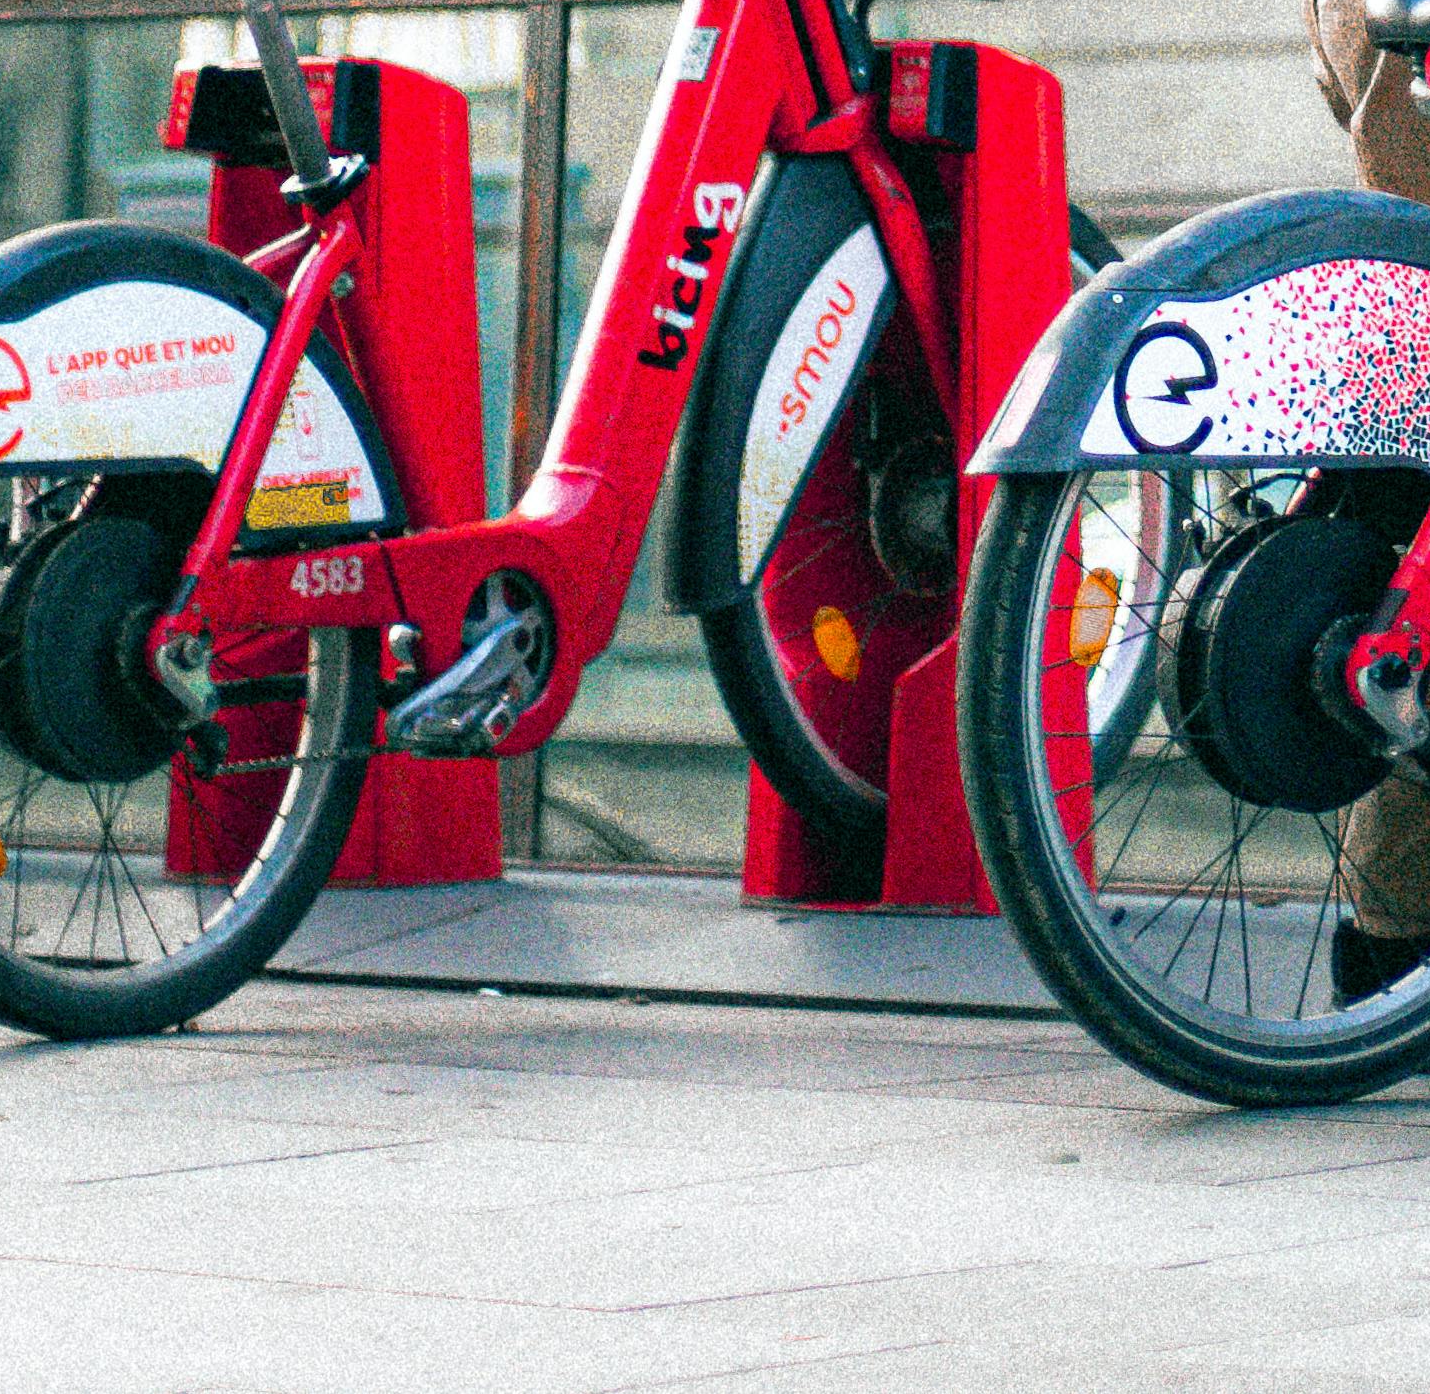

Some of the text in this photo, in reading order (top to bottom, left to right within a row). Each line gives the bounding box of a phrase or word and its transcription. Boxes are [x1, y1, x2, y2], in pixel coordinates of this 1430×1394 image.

[637, 182, 744, 372] bicing
[47, 333, 237, 377] L'APP QUE ET MOU
[290, 555, 365, 598] 4583
